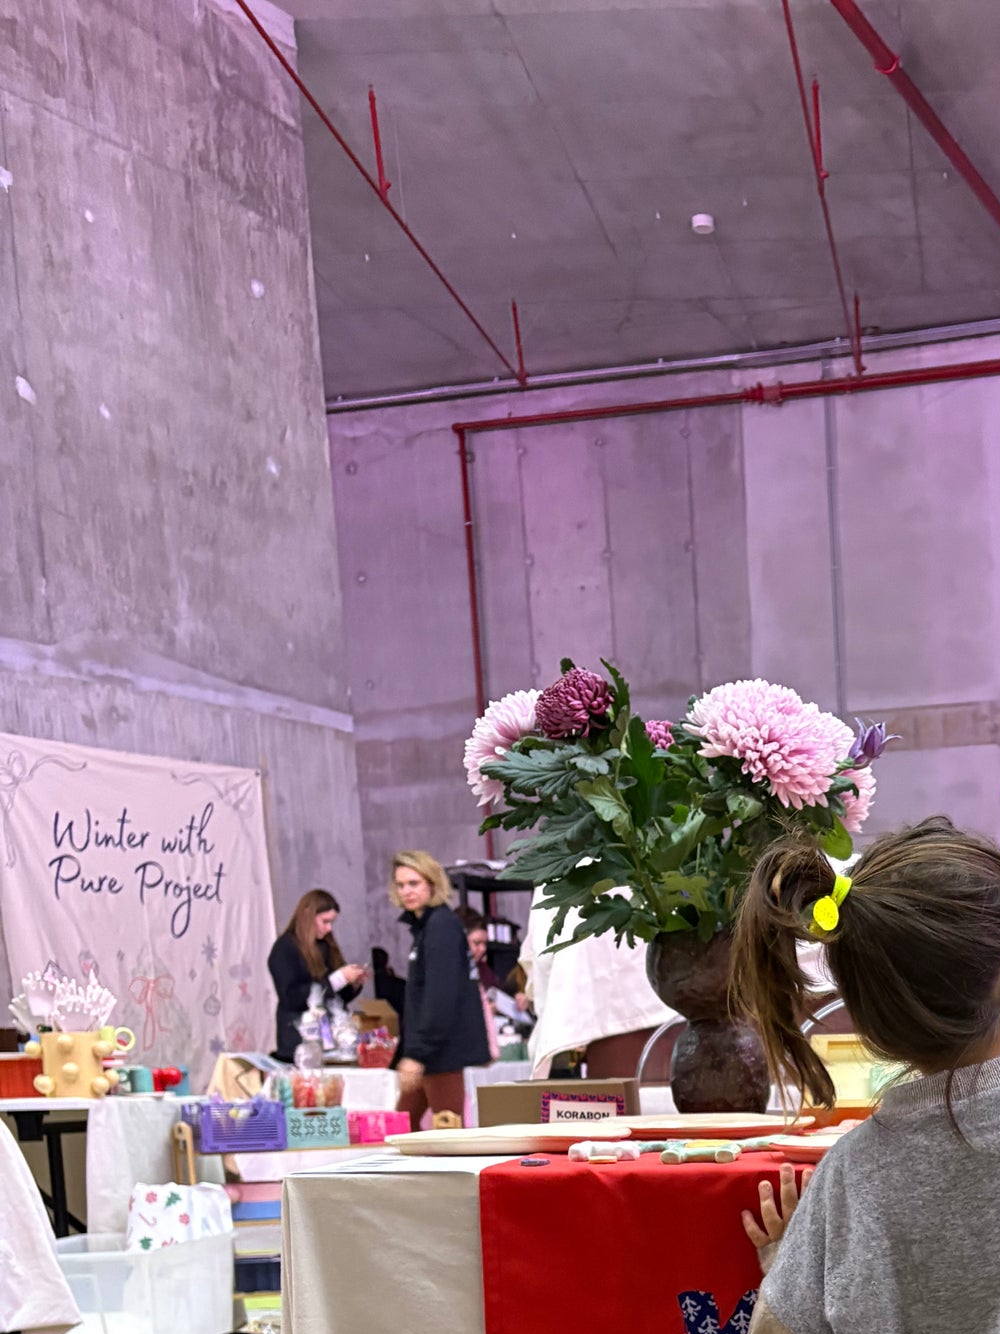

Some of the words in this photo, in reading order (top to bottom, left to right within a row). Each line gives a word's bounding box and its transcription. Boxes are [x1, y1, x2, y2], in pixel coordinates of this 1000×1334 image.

[53, 807, 149, 852] Winter
[161, 802, 215, 855] with
[49, 854, 125, 900] Pure
[135, 861, 227, 938] Project
[556, 1110, 610, 1120] KORABON
